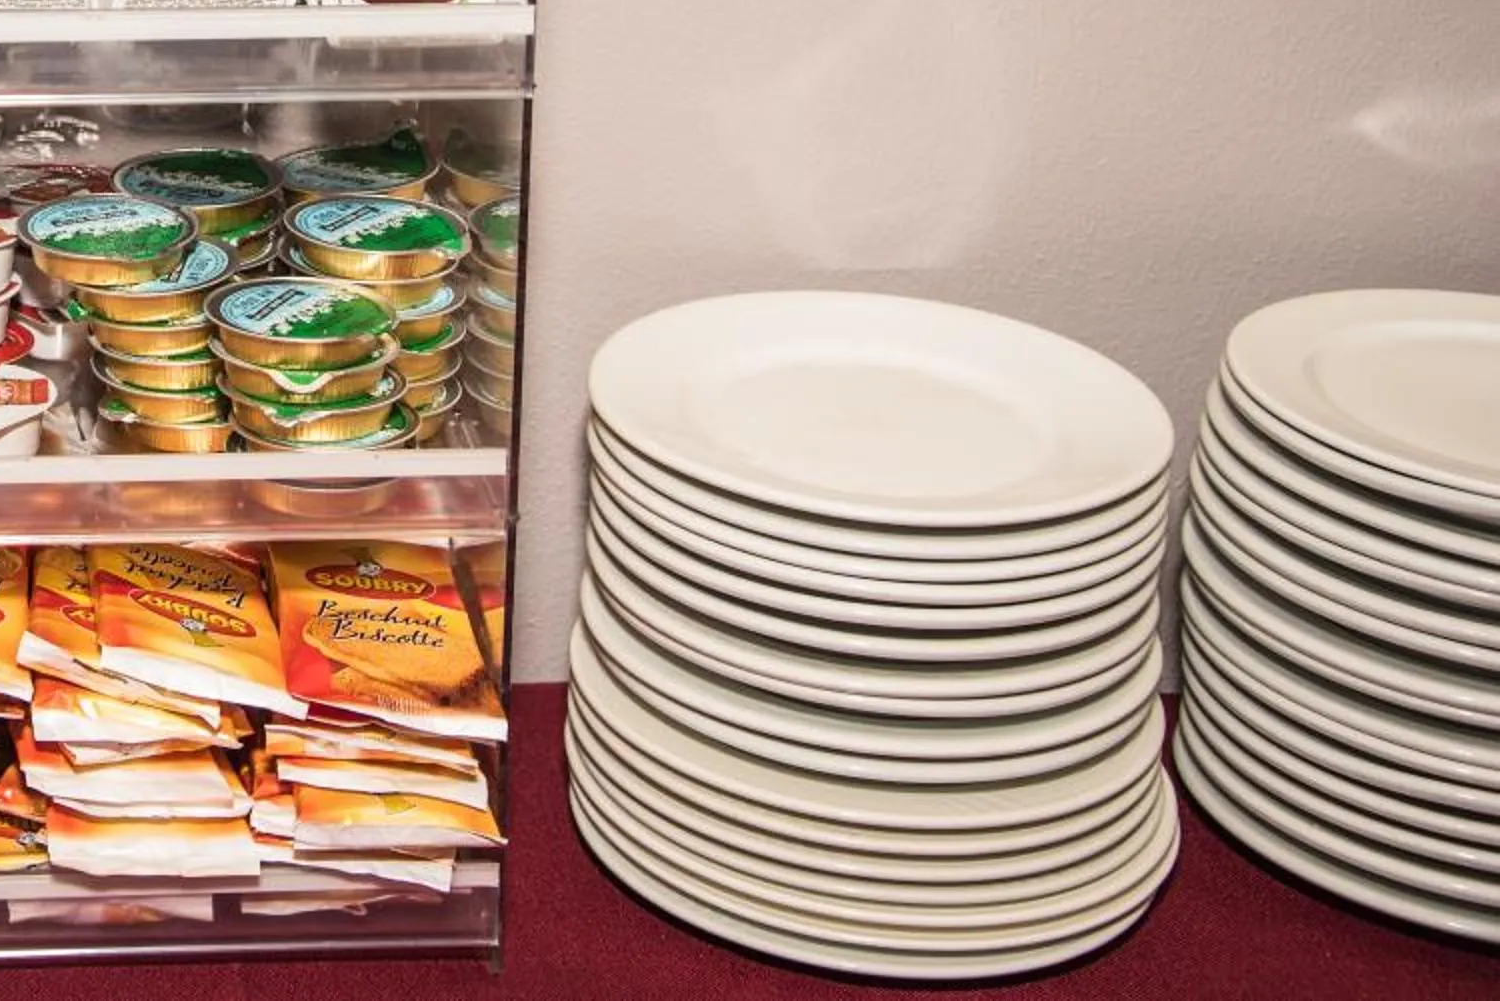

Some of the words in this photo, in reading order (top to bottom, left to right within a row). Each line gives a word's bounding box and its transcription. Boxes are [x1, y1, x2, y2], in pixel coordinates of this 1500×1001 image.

[315, 572, 428, 595] SOUBRY
[317, 599, 448, 630] Beschuit
[330, 618, 445, 648] Biscotte
